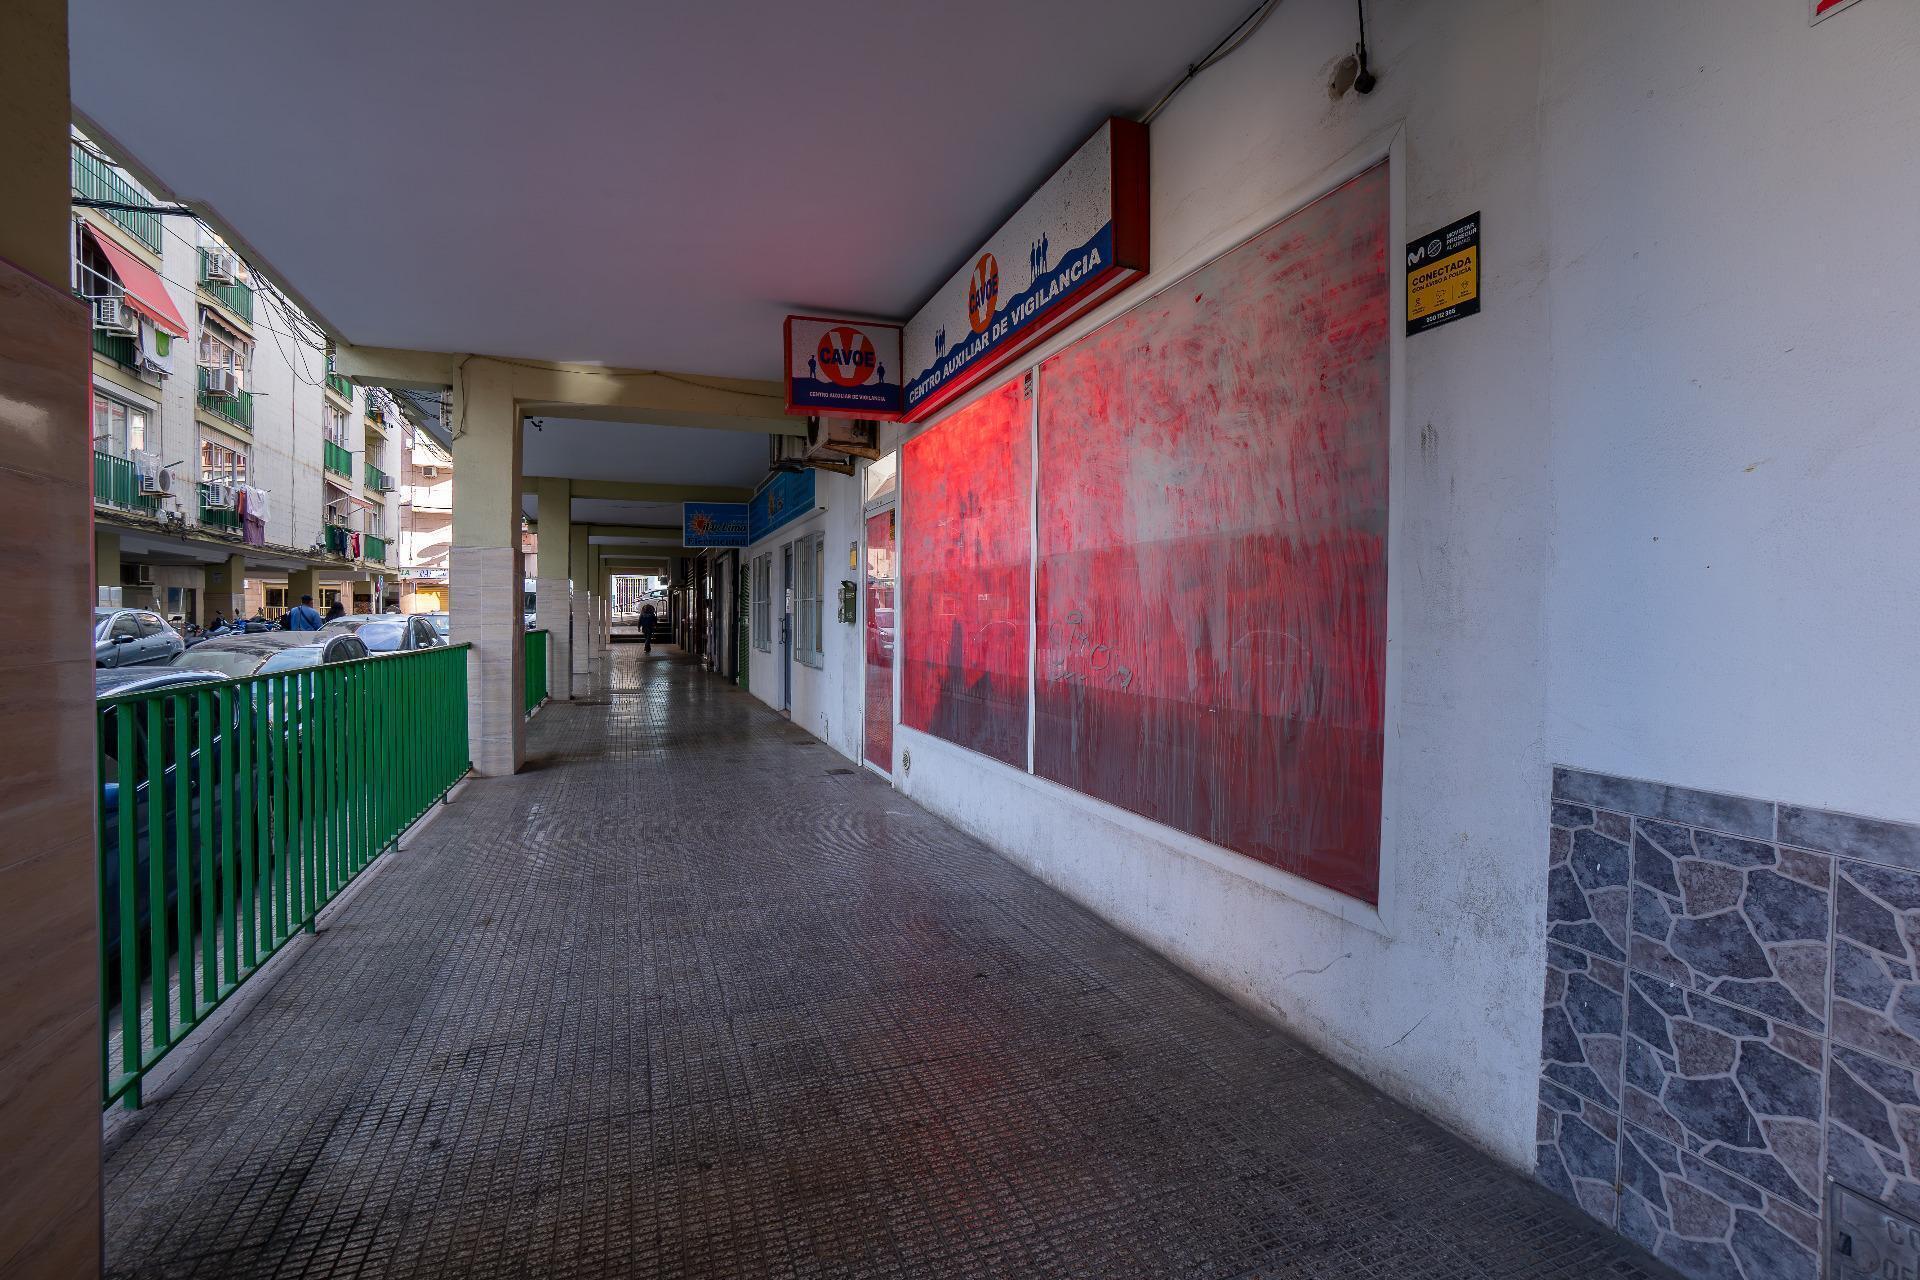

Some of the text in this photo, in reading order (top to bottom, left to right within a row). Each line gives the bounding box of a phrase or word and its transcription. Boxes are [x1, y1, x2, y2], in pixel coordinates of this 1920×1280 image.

[1446, 227, 1477, 246] PROSEGUR
[1412, 257, 1472, 287] CONECTADA
[969, 274, 999, 314] CAVOE
[1411, 285, 1425, 294] CON
[909, 248, 1101, 404] CENTRO AUXILIAR DE VIGILANCIA
[820, 347, 875, 368] CAVOE
